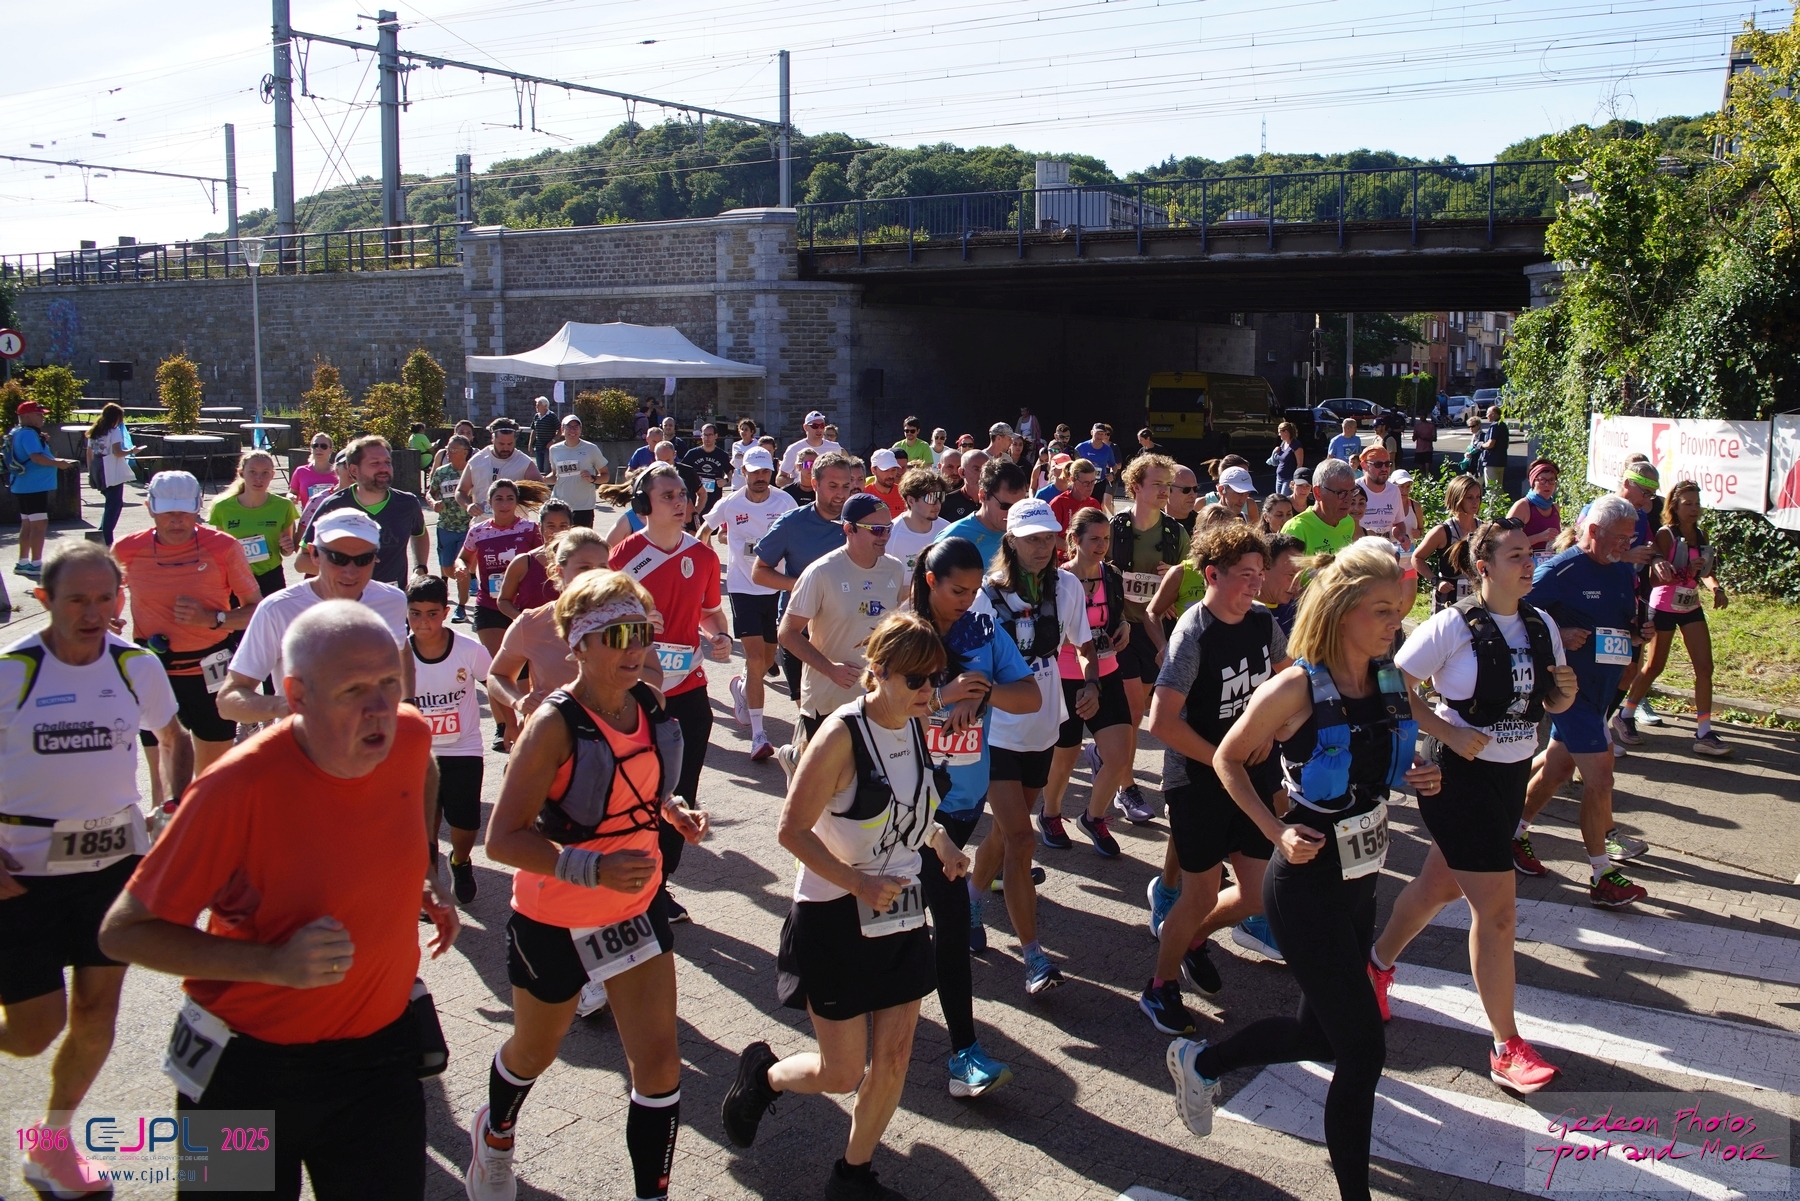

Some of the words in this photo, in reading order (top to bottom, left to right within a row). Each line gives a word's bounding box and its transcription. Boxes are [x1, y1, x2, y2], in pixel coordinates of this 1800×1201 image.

[1602, 425, 1629, 449] Province
[1680, 431, 1740, 459] Province
[558, 463, 578, 473] 1843
[443, 483, 458, 493] 187
[1693, 464, 1738, 504] Liège
[243, 542, 262, 557] 80
[483, 554, 497, 562] 15
[1125, 579, 1157, 595] 1611
[1460, 584, 1472, 596] 15
[1603, 636, 1629, 655] 820
[208, 662, 227, 681] 17
[1220, 644, 1272, 702] MJ
[413, 687, 467, 709] mirates
[1218, 693, 1253, 720] SPO
[33, 720, 95, 733] Challenge
[427, 714, 458, 734] 076
[926, 728, 979, 752] 1078
[889, 750, 907, 760] CRAFT
[62, 826, 127, 856] 1853
[585, 914, 653, 961] 1860
